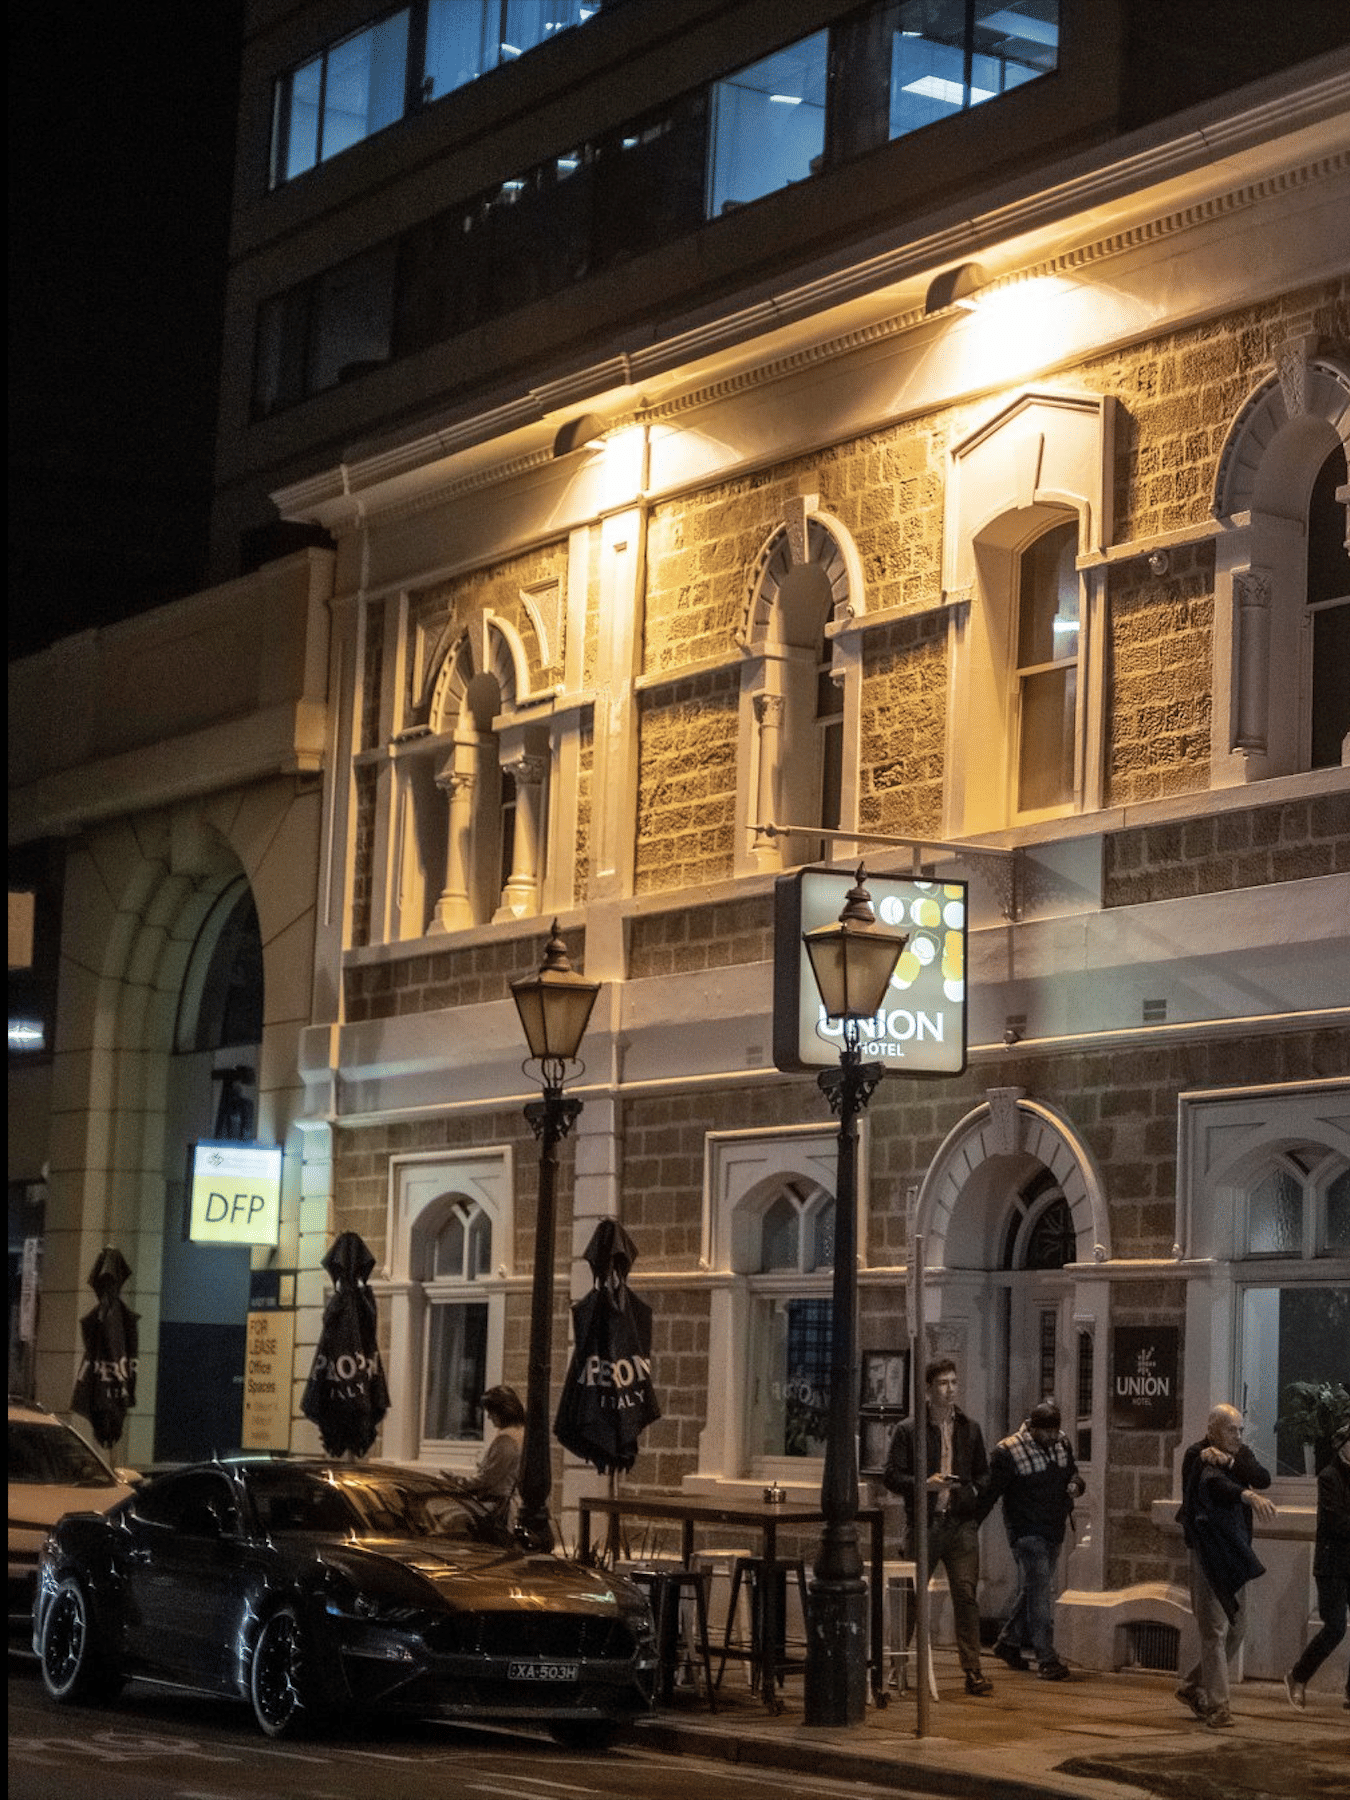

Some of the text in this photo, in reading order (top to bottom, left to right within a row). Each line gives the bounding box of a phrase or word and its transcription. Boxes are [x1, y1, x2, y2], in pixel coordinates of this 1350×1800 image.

[204, 1191, 265, 1224] DFP
[249, 1338, 277, 1355] LEASE
[1116, 1376, 1170, 1396] UNION
